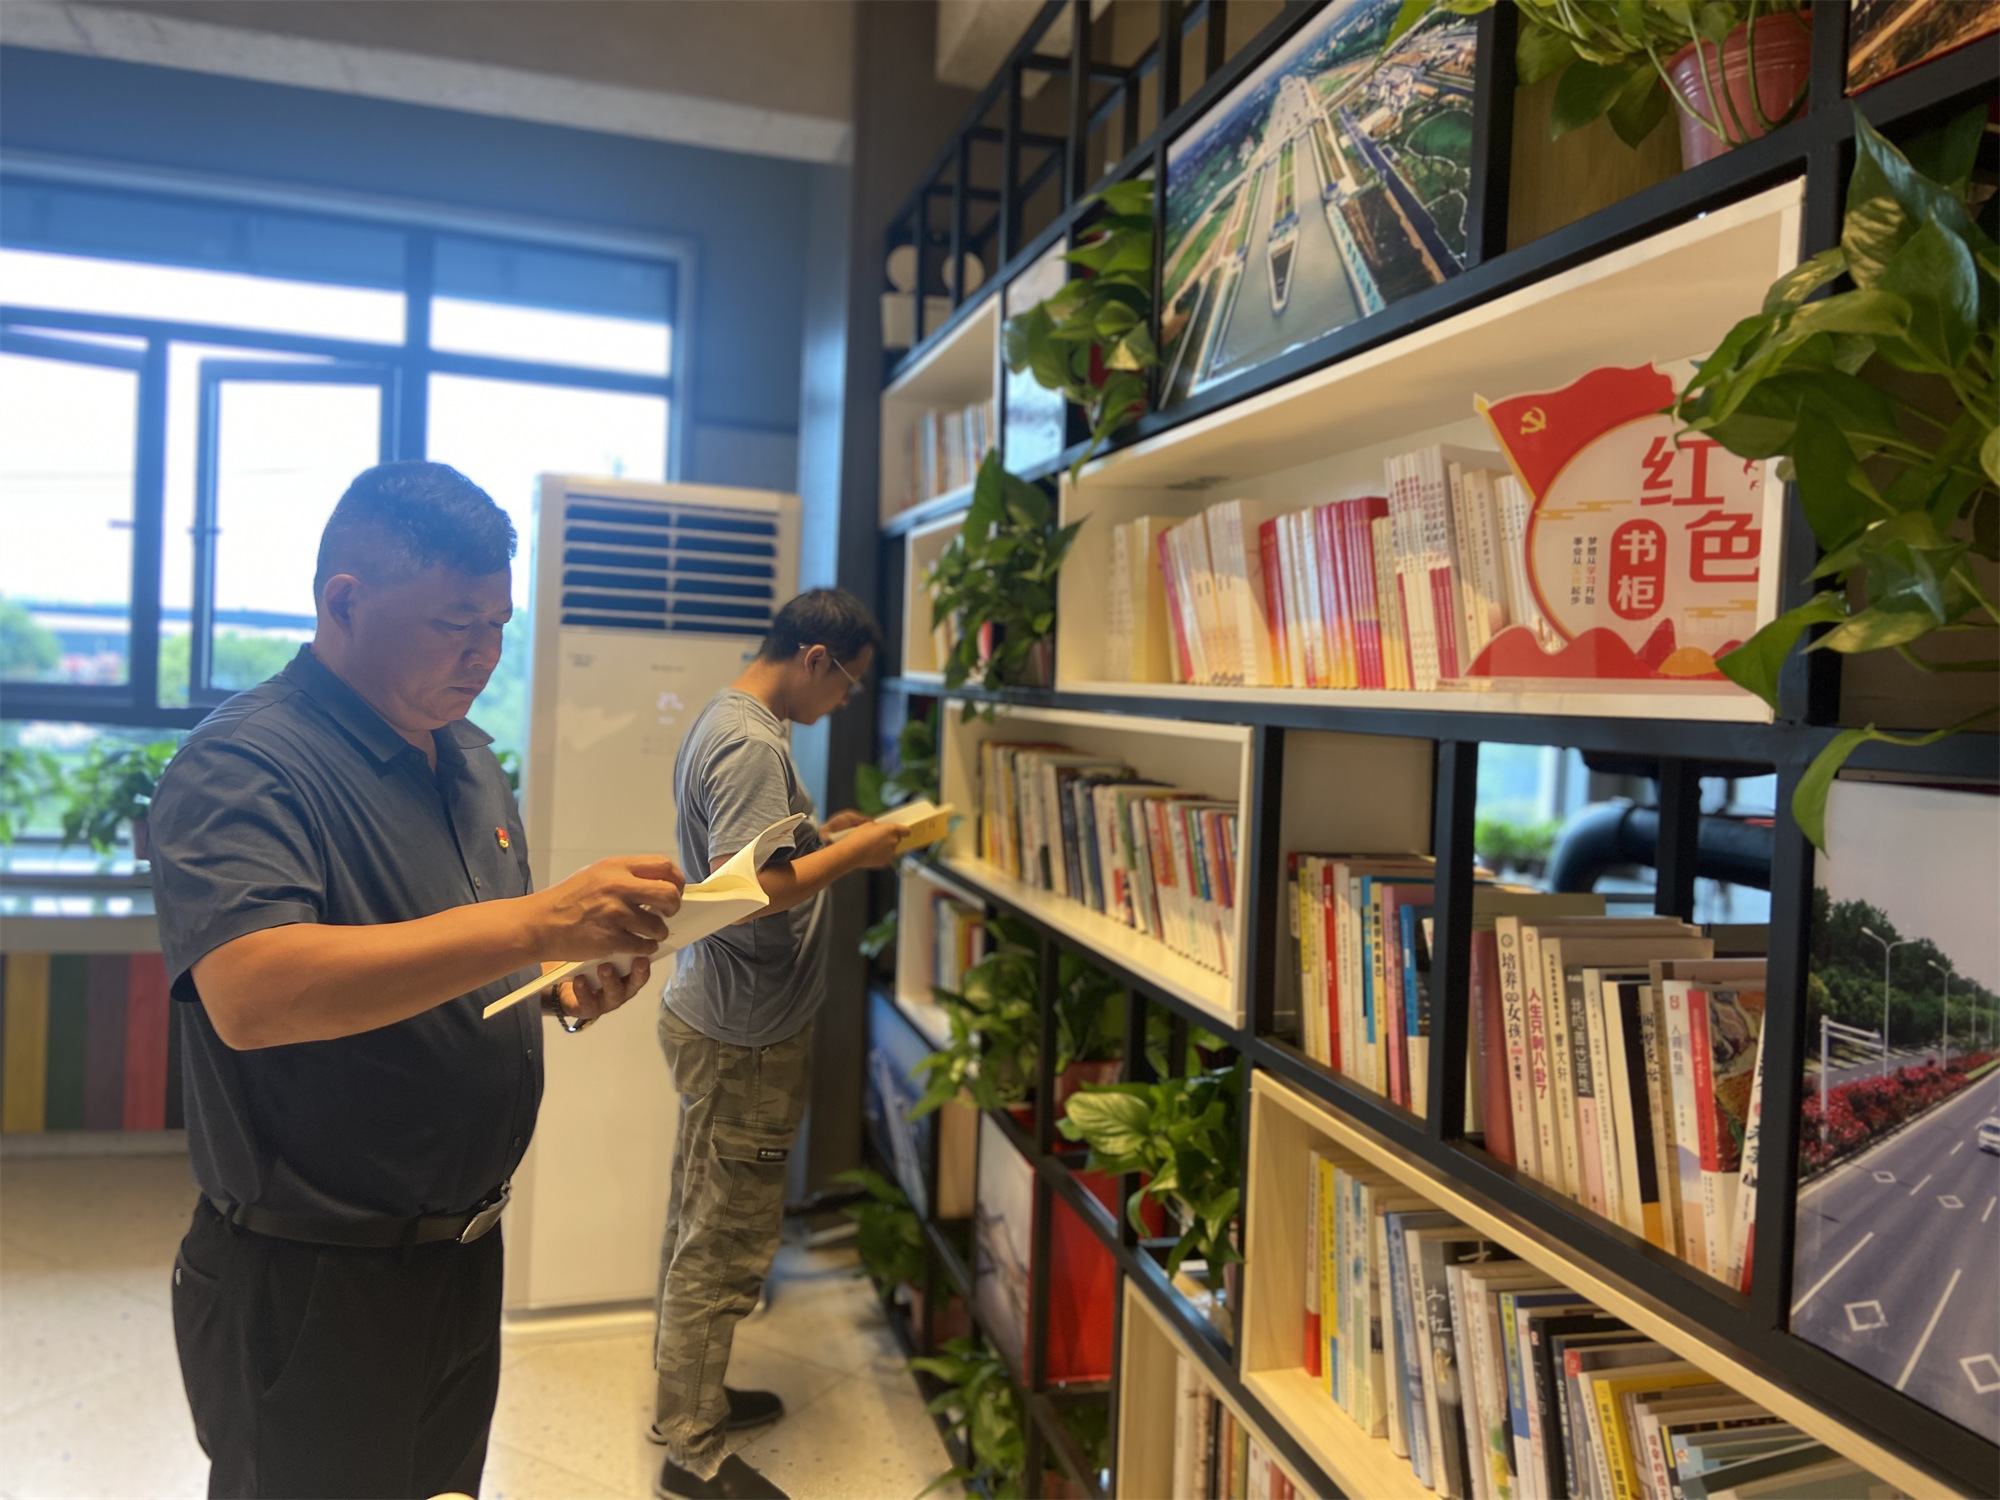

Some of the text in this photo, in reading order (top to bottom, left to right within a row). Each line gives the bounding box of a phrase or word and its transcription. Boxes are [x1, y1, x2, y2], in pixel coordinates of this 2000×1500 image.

[1570, 537, 1582, 605] 事业从实践起步
[1584, 536, 1597, 605] 梦想从学习开始
[1616, 528, 1658, 611] 书柜
[1528, 987, 1547, 1099] 人生只剩八卦了
